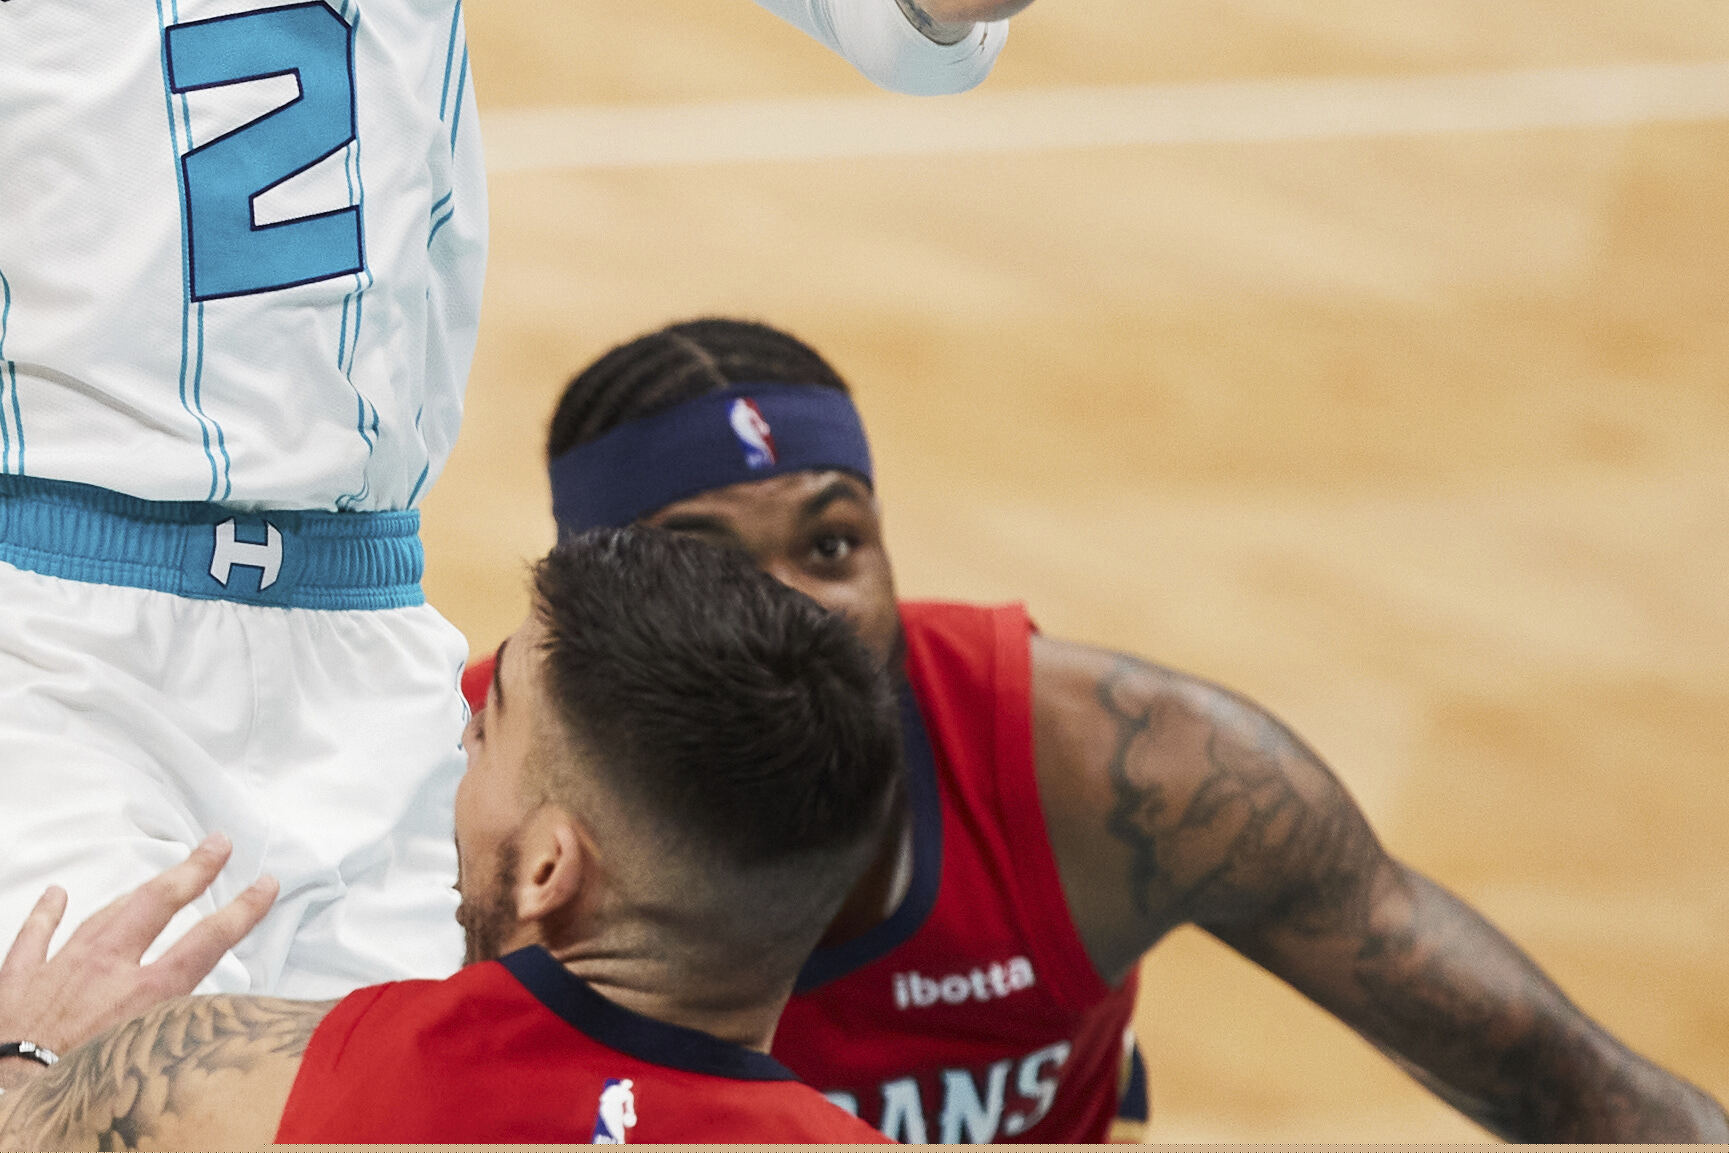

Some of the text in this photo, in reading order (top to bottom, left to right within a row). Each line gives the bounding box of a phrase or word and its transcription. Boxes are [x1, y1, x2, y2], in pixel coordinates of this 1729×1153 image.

[166, 0, 364, 303] 2
[893, 955, 1035, 1010] ibotta
[825, 1039, 1070, 1144] ANS
